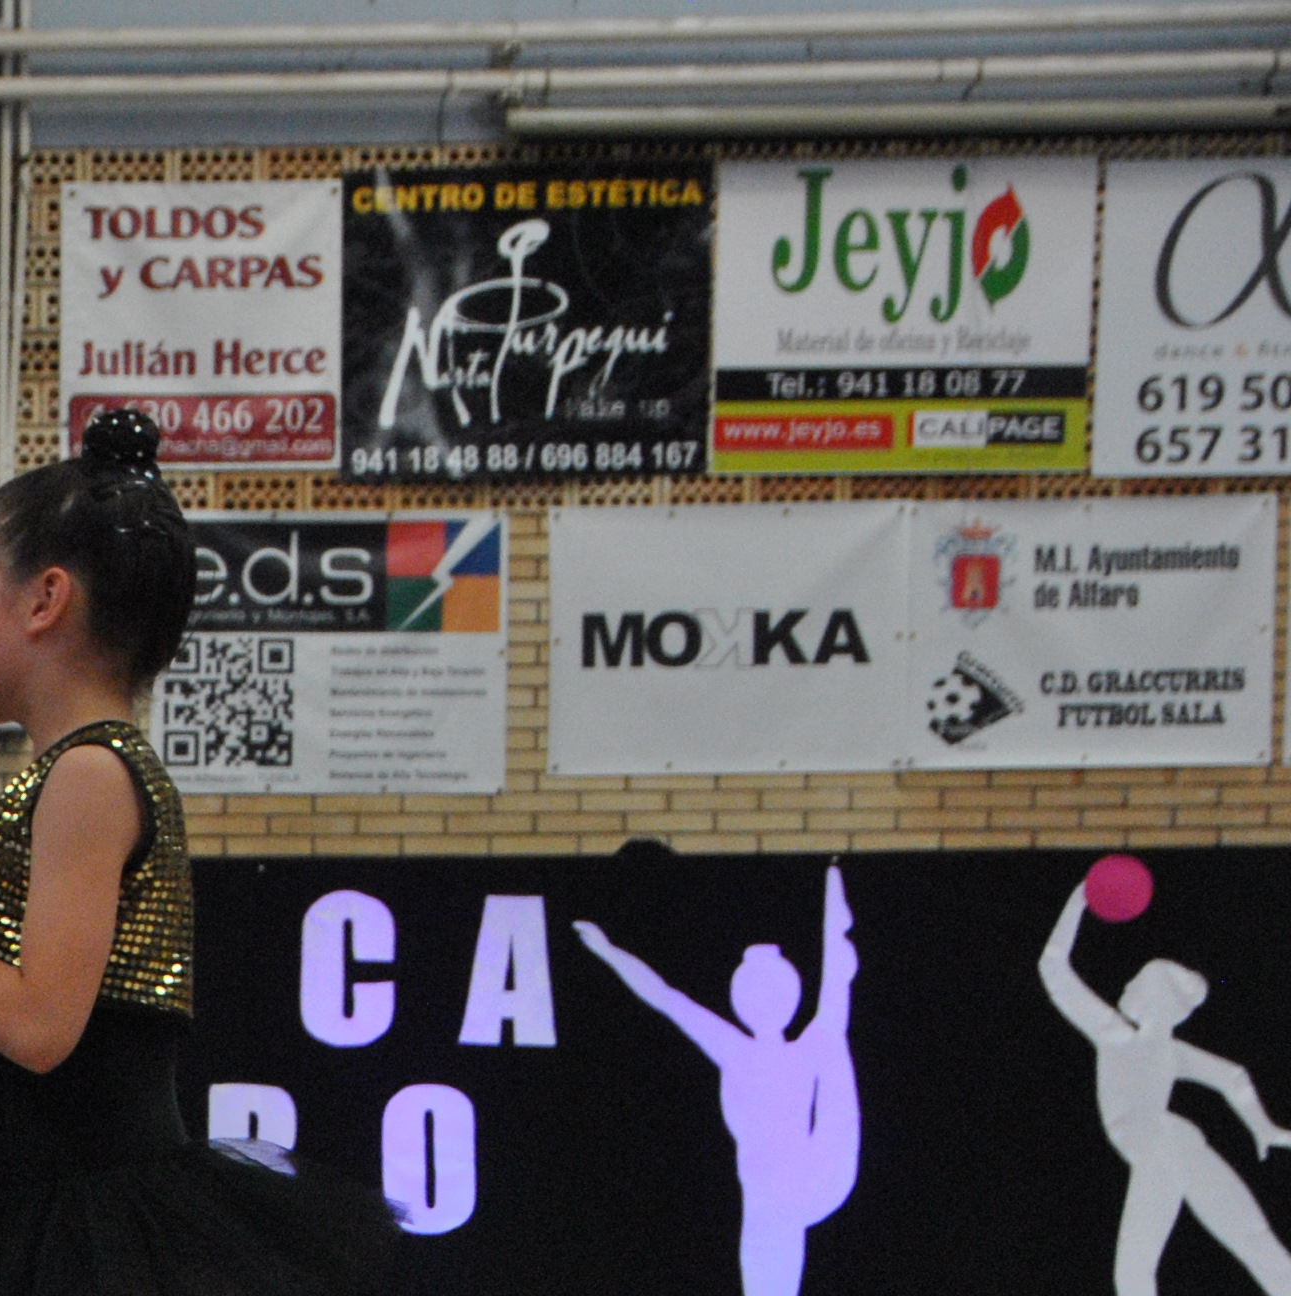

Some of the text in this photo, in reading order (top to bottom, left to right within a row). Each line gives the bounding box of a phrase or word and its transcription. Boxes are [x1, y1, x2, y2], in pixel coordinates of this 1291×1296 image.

[351, 183, 485, 213] CENTRO
[494, 181, 537, 209] DE
[83, 204, 266, 240] TOLDOS
[98, 254, 324, 300] y CARPAS
[78, 338, 327, 377] Julián Herce
[836, 371, 888, 397] 941
[903, 370, 937, 396] 18
[945, 370, 981, 396] 08
[990, 370, 1027, 395] 77
[1137, 373, 1225, 412] 619
[122, 399, 325, 435] 30 466 202
[723, 419, 883, 445] www.jeyjo.es
[351, 448, 398, 476] 941
[408, 445, 438, 472] 18
[487, 444, 519, 471] 88
[540, 443, 589, 471] 696
[595, 442, 643, 470] 884
[652, 441, 698, 469] 167
[1135, 426, 1288, 464] 657 31
[1087, 542, 1240, 576] Ayuntamiento
[1034, 579, 1139, 608] de Alfaro
[1057, 701, 1227, 729] FUTBOL SALA
